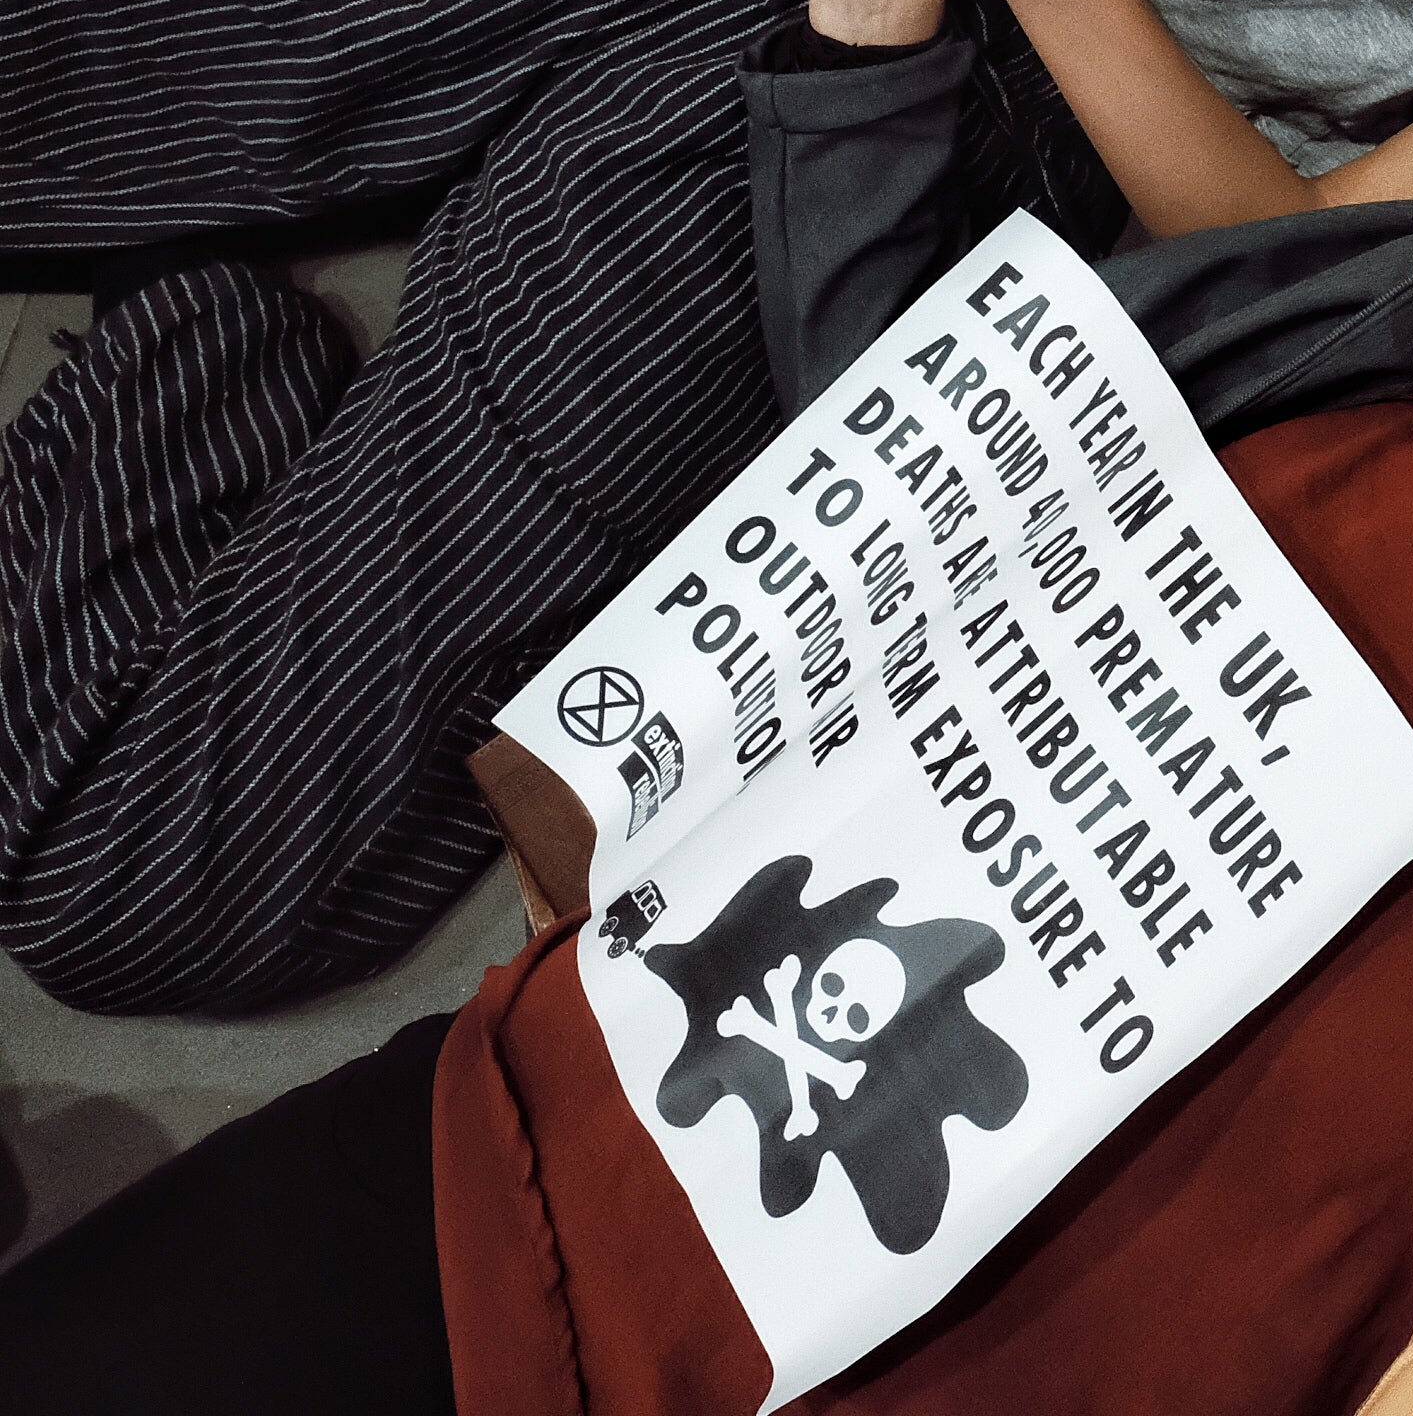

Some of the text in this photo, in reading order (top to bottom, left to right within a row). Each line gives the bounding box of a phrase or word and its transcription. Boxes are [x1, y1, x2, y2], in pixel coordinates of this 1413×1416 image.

[725, 515, 852, 710] OUTDOOR
[785, 447, 864, 528] TO
[849, 518, 916, 627] LONG
[910, 704, 1106, 988] EXPOSURE
[1079, 975, 1154, 1074] TO
[842, 385, 1213, 969] DEATHS ARE ATTRIBUTABLE
[904, 332, 1303, 919] AROUND 40,000 PREMATURE
[966, 261, 1313, 767] EACH YEAR IN THE UK,
